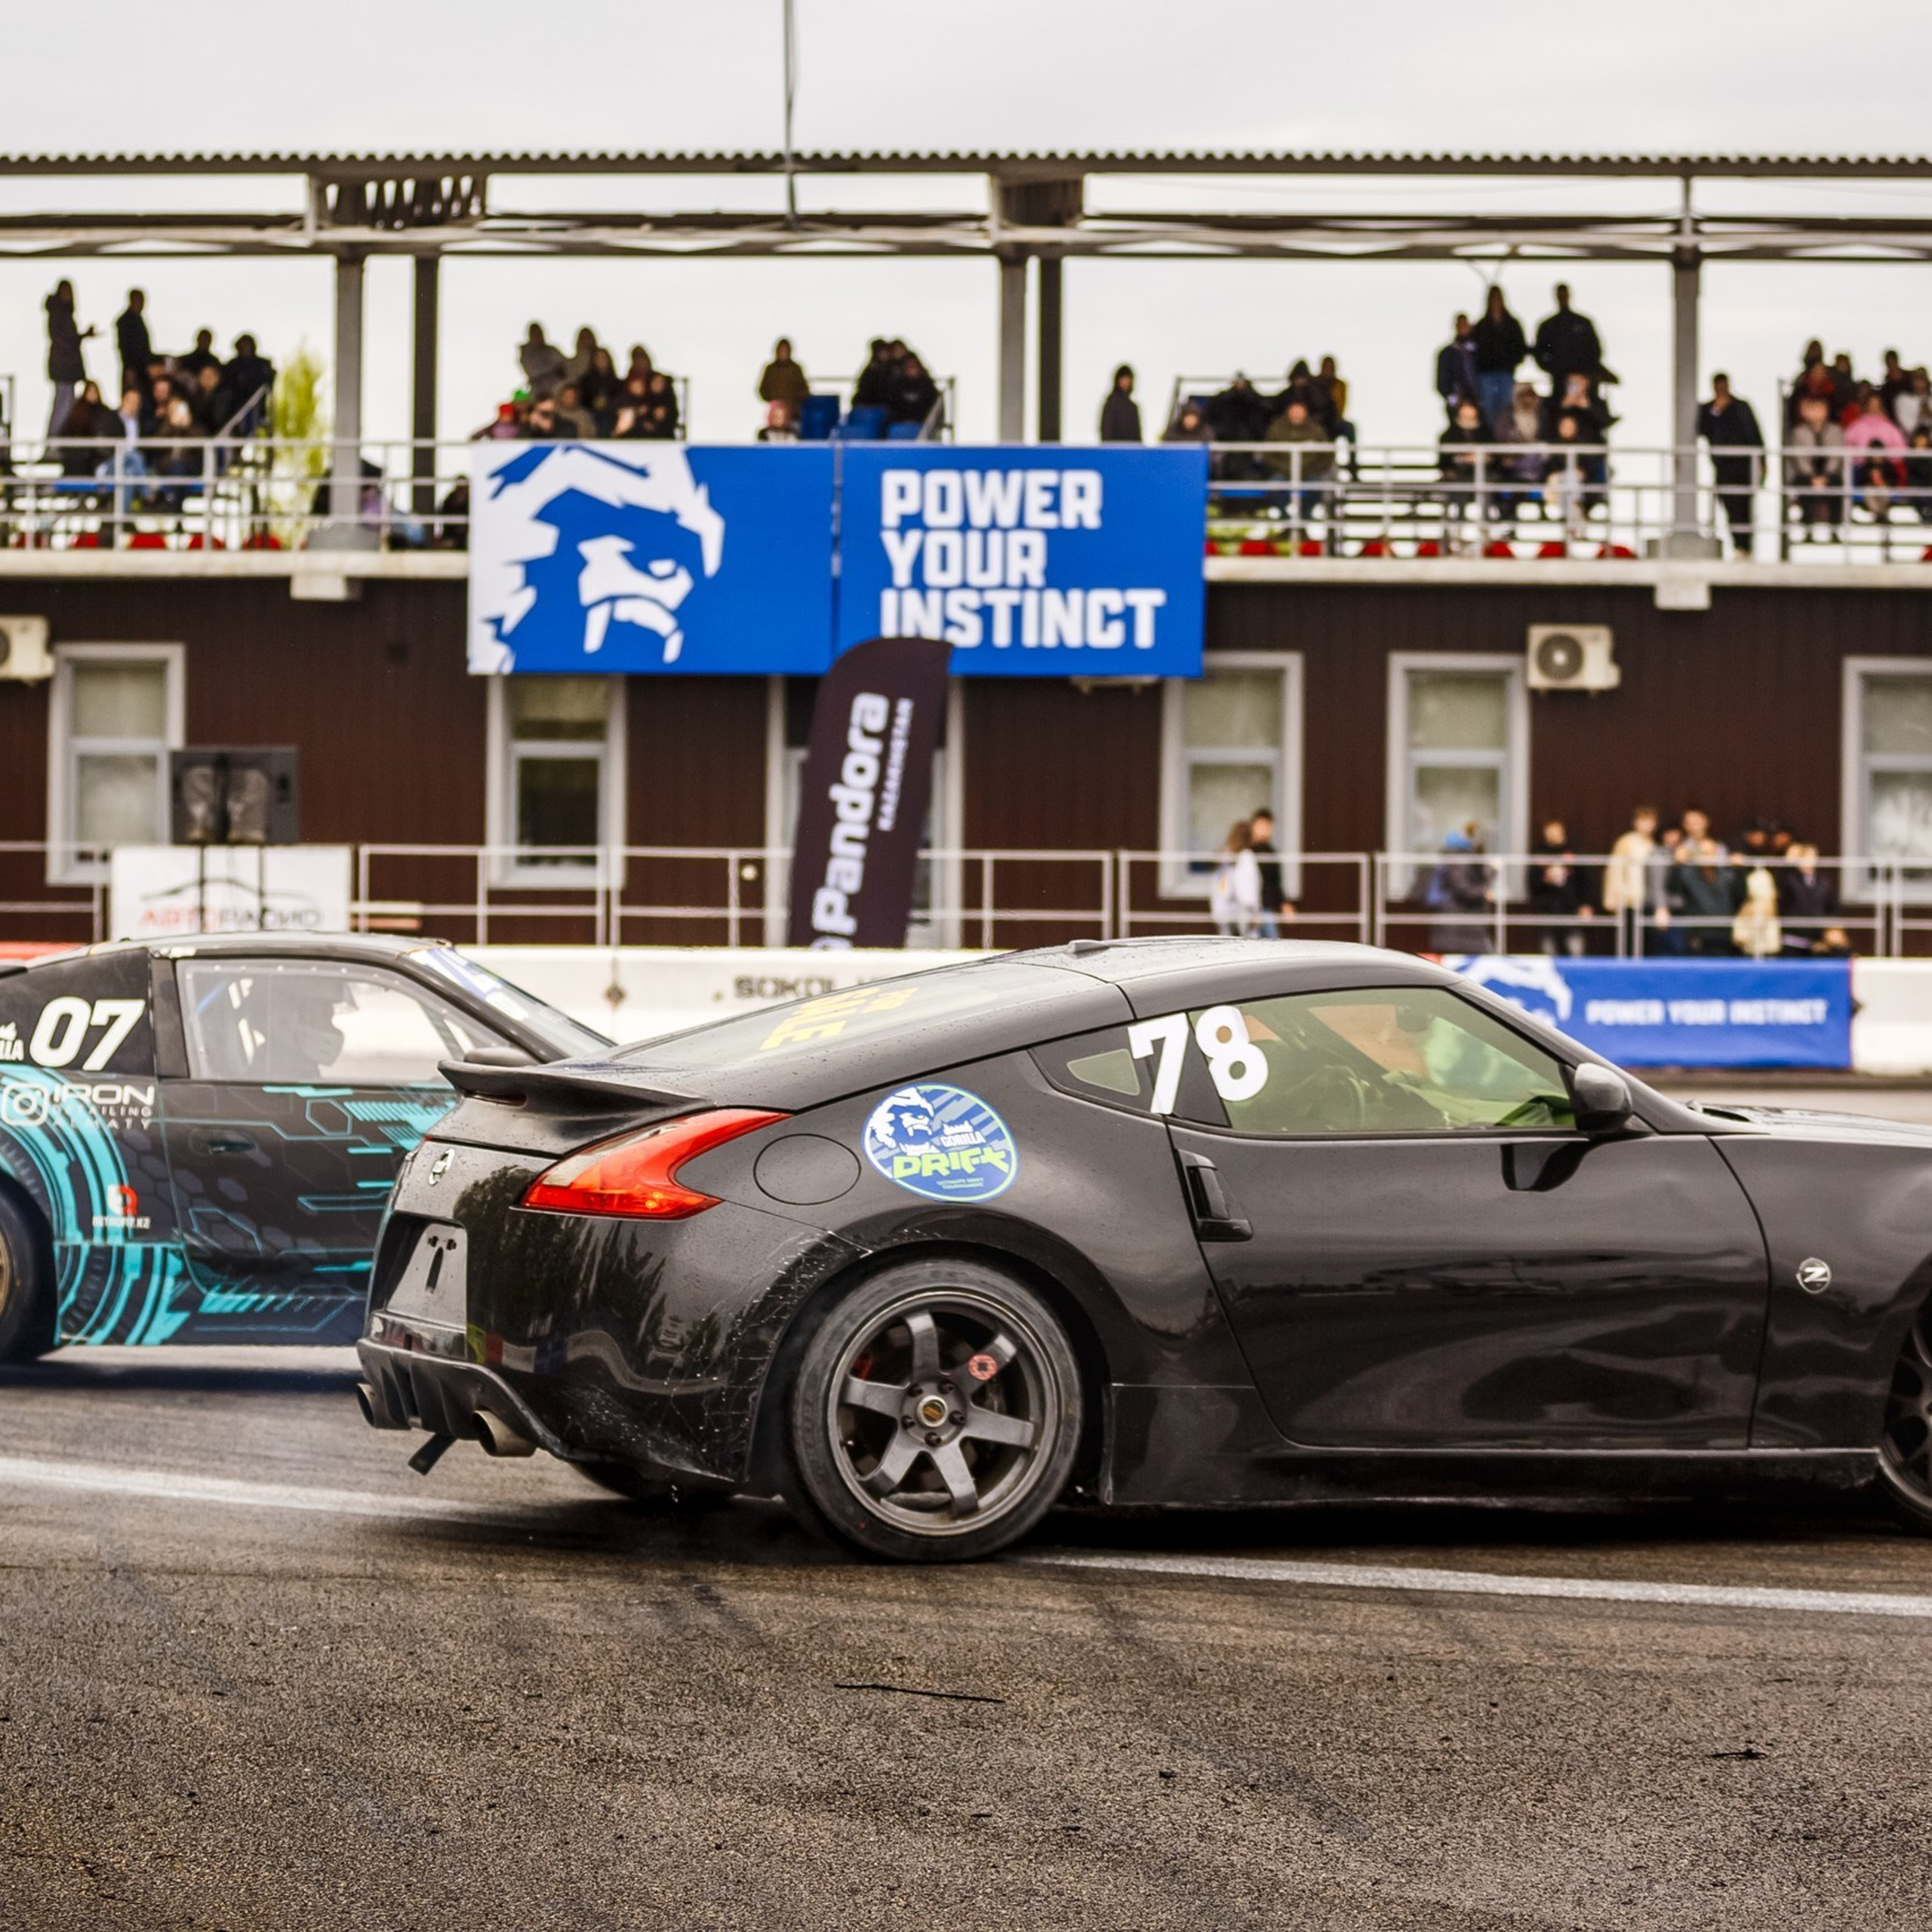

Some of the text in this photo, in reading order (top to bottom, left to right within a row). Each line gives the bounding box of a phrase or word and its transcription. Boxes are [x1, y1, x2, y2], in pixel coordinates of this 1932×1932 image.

[881, 469, 1103, 530] POWER
[881, 529, 1048, 589] YOUR
[880, 588, 1167, 649] INSTINCT
[876, 697, 914, 831] KAZAKHSTAN
[811, 691, 890, 936] Pandora
[29, 995, 146, 1072] 07
[1586, 998, 1829, 1026] POWER YOUR INSTINCT
[1127, 1004, 1269, 1115] 78
[54, 1084, 155, 1106] IRON
[54, 1104, 152, 1118] DAILING
[893, 1146, 1010, 1180] DRIFT
[940, 1131, 986, 1148] GORILLA
